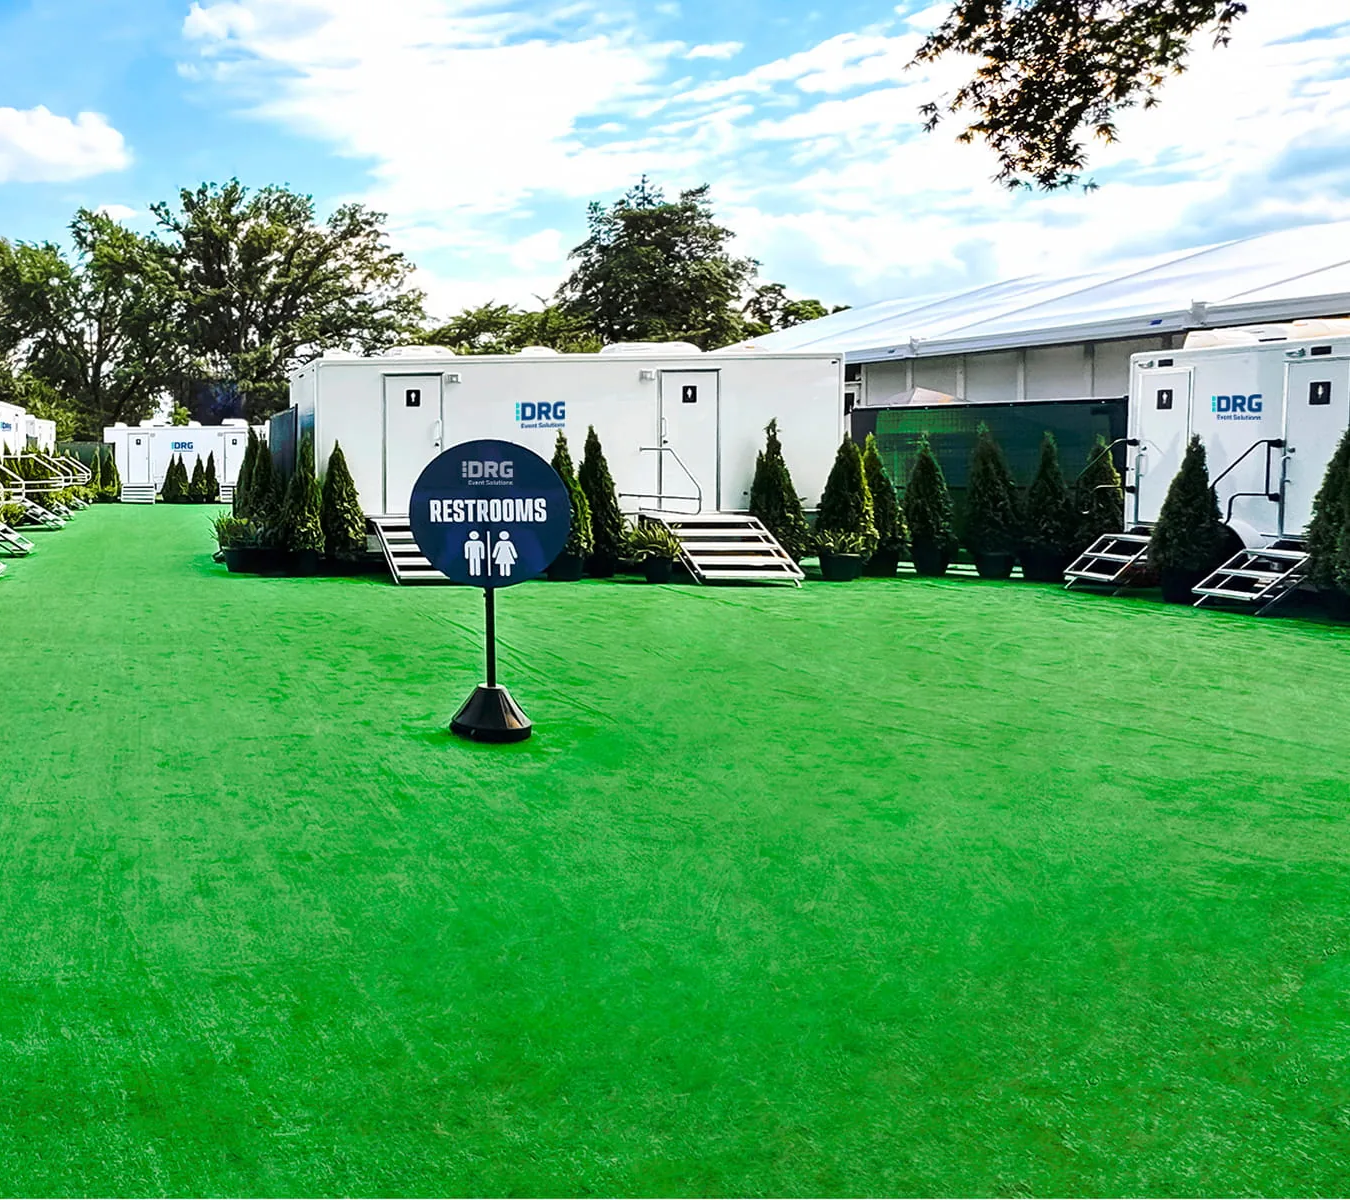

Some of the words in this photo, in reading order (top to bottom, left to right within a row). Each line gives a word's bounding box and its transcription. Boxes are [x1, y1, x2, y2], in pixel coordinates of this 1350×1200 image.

[521, 401, 566, 421] DRG
[1217, 394, 1263, 413] DRG
[174, 441, 194, 450] DRG
[468, 461, 514, 479] DRG
[429, 498, 548, 523] RESTROOMS
